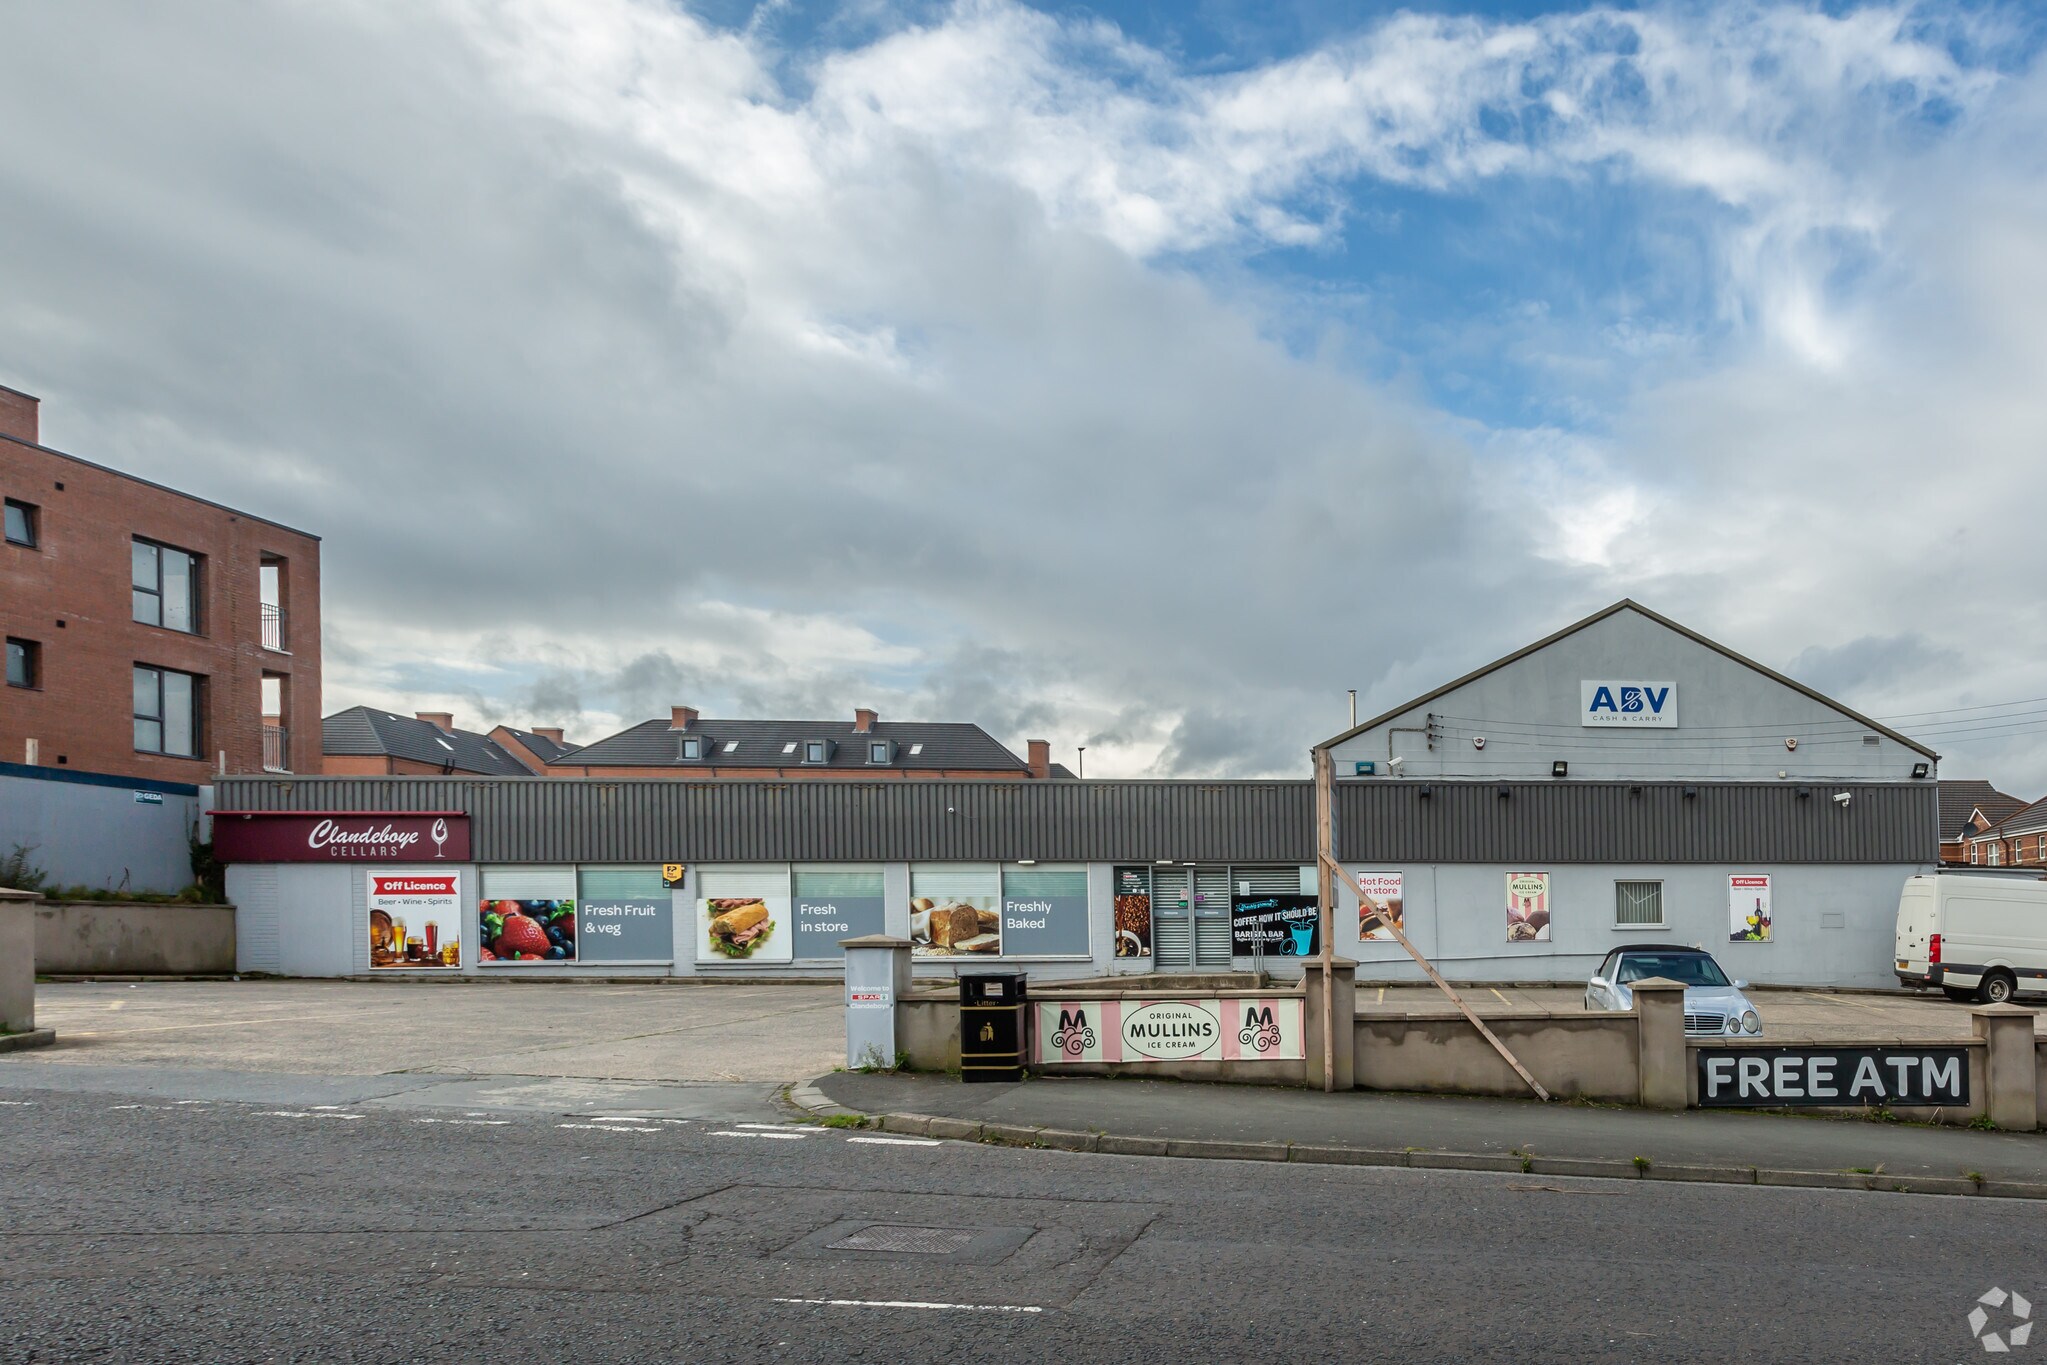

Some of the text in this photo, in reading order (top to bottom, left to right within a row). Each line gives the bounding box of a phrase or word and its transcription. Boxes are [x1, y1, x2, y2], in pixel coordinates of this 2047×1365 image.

[1589, 686, 1669, 713] ABV
[308, 819, 419, 849] Clandeboye
[331, 846, 398, 857] CELLARS
[383, 881, 447, 891] Off Licence
[1359, 877, 1401, 886] Hot Food
[1363, 886, 1398, 895] in store
[427, 897, 453, 906] Spirits
[1006, 900, 1052, 915] Freshly
[585, 904, 657, 916] Fresh Fruit
[800, 903, 837, 915] Fresh
[1007, 917, 1046, 929] Baked
[1233, 906, 1317, 928] COFFEE HOW IT SHOULD BE
[584, 922, 622, 937] & veg
[800, 920, 849, 932] in store
[1268, 930, 1284, 938] BAR
[1149, 1012, 1192, 1020] ORIGINAL
[1130, 1022, 1212, 1038] MULLINS
[1147, 1041, 1196, 1049] ICE CREAM
[1707, 1056, 1960, 1098] FREE ATM
